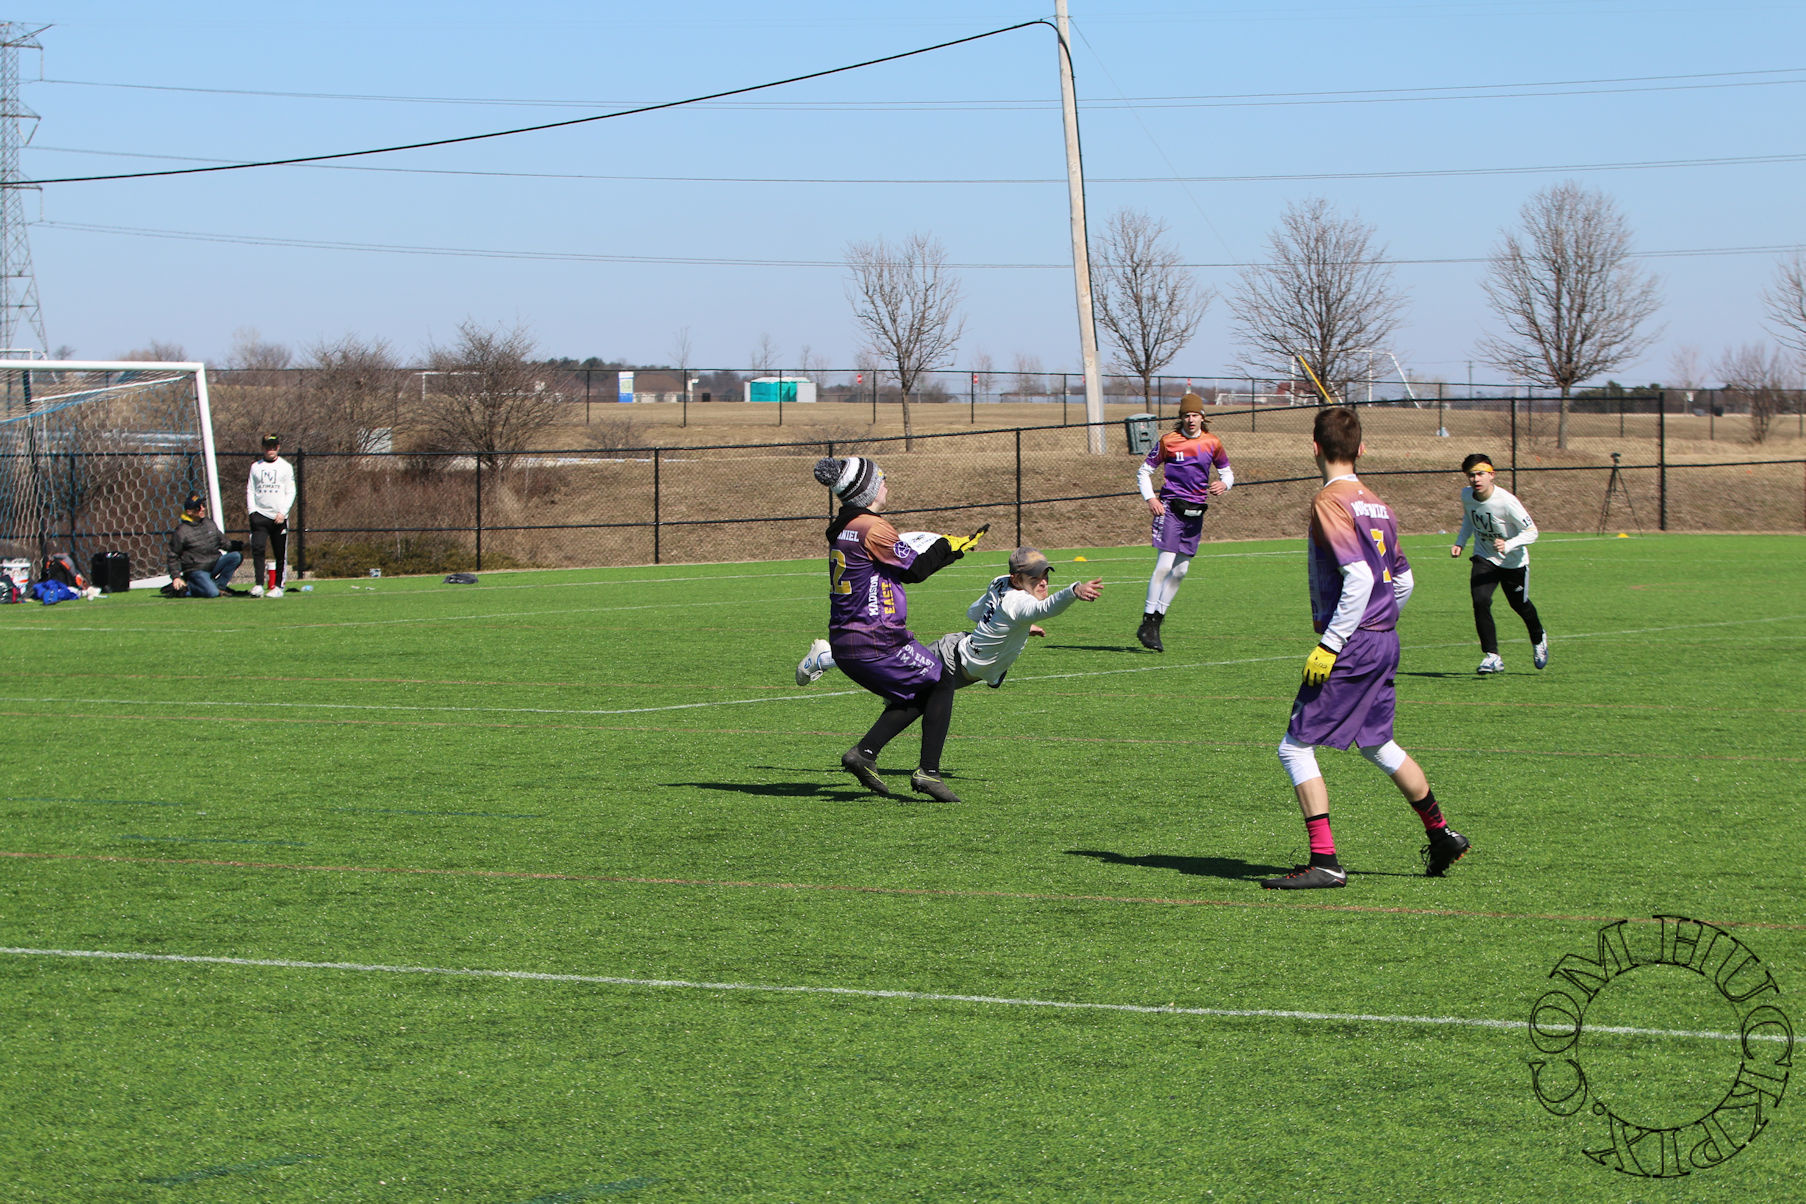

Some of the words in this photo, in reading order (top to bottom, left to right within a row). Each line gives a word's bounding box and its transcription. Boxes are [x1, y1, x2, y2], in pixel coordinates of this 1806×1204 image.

[1175, 452, 1185, 461] 11
[868, 575, 880, 617] MADISON
[881, 581, 896, 615] EAST
[914, 652, 935, 669] EAST
